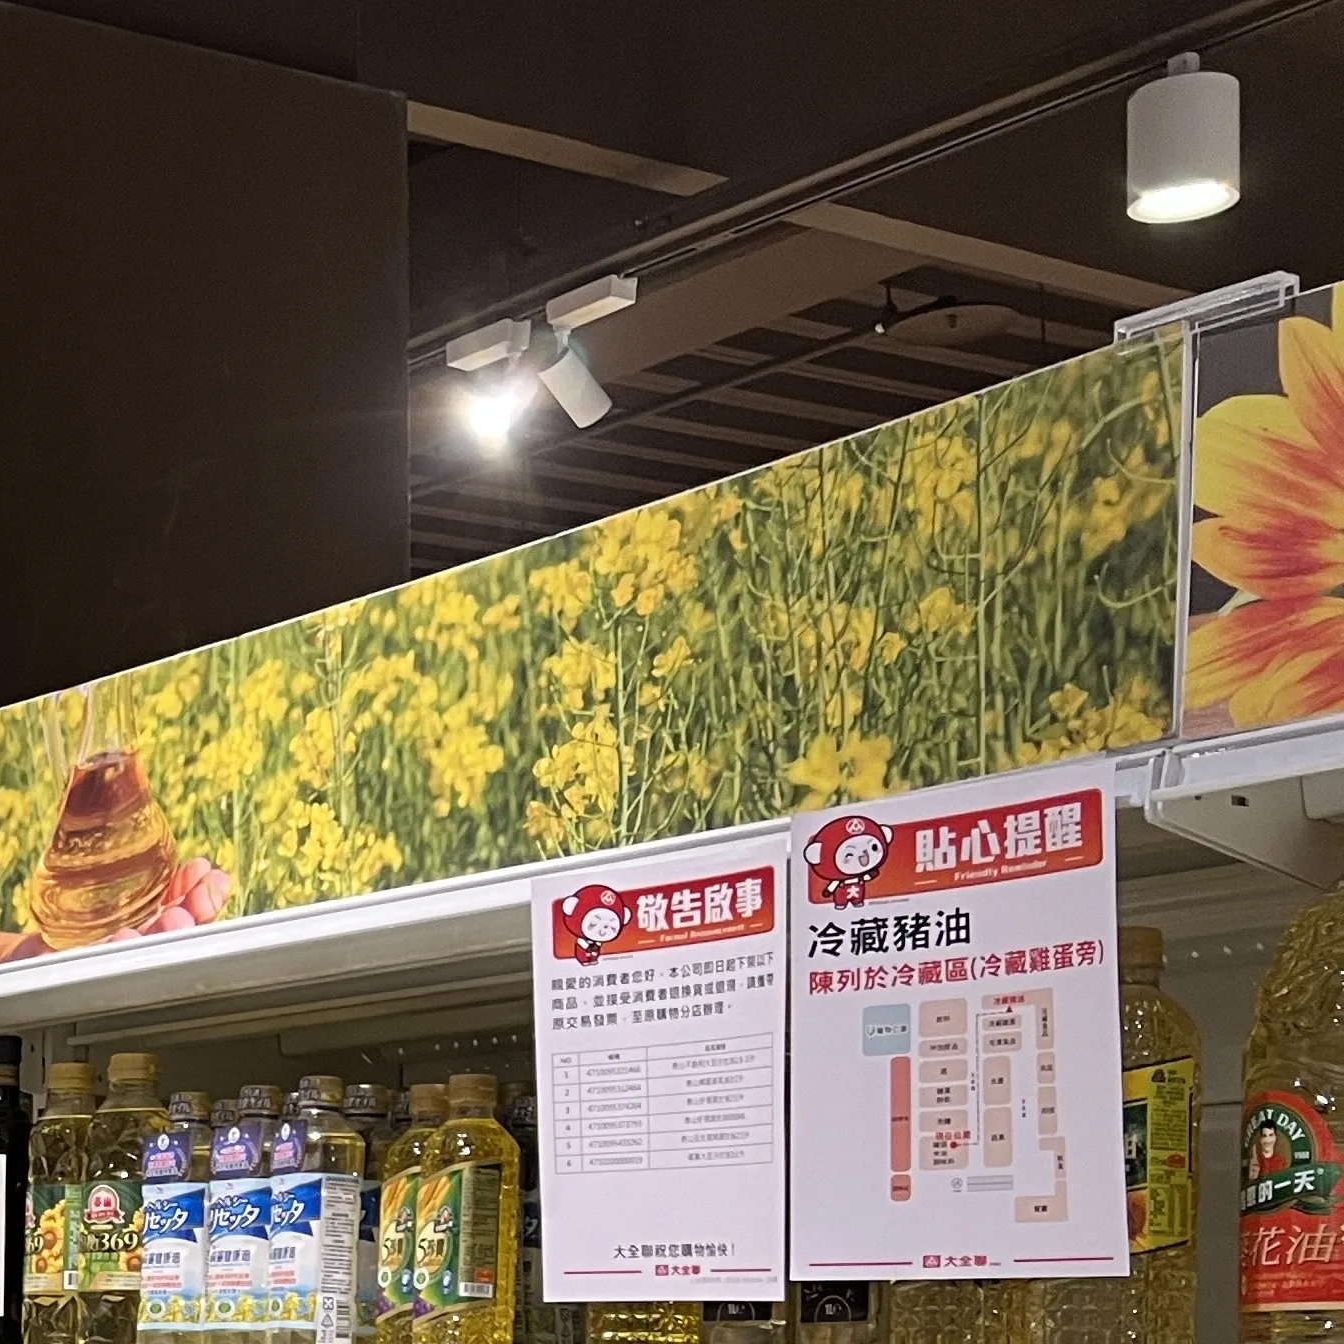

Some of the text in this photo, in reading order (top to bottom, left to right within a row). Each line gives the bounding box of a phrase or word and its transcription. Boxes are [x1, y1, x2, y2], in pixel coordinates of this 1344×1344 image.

[914, 802, 1082, 873] 貼心提醒
[954, 859, 1047, 881] Friendly Reminder
[808, 907, 971, 958] 冷藏豬油
[809, 940, 1105, 995] 陳列於冷藏區(冷藏雞蛋旁)
[1277, 1113, 1305, 1141] DAY
[272, 1200, 304, 1227] セッタ
